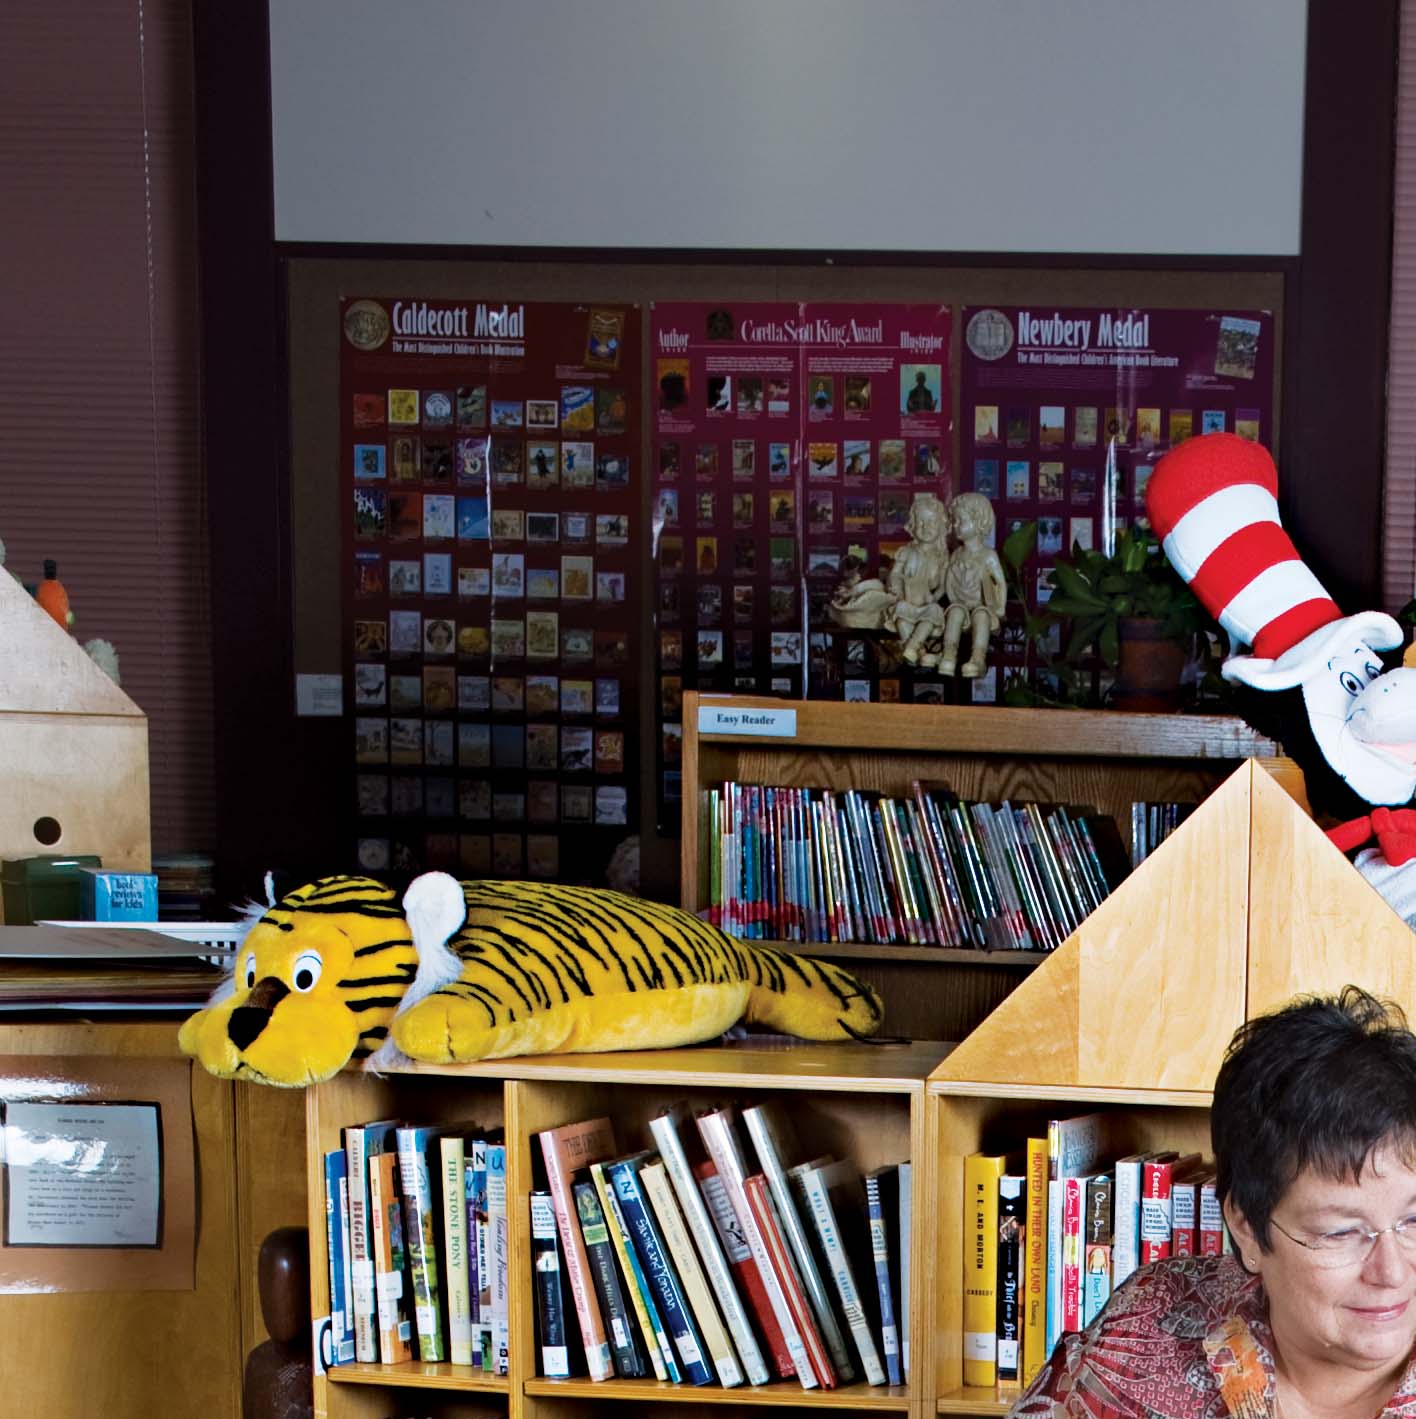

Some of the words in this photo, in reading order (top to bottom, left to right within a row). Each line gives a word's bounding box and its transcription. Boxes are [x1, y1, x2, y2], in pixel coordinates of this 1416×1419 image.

[392, 302, 468, 336] Caldecott
[474, 304, 525, 338] Medal
[816, 320, 847, 348] King
[846, 320, 883, 344] Award
[1018, 312, 1091, 350] Newbery
[1097, 313, 1149, 347] Medal
[659, 328, 689, 348] Author
[900, 331, 943, 351] Illustrator
[716, 713, 739, 726] Easy
[742, 714, 776, 725] Reader
[475, 1151, 486, 1165] N
[1033, 1152, 1043, 1192] HUNTED
[448, 1158, 457, 1187] THE
[449, 1190, 460, 1234] STONE
[1033, 1195, 1042, 1206] IN
[1032, 1209, 1042, 1237] THEIR
[451, 1235, 462, 1271] PONY
[1031, 1240, 1041, 1264] OWN
[1030, 1267, 1041, 1294] LAND
